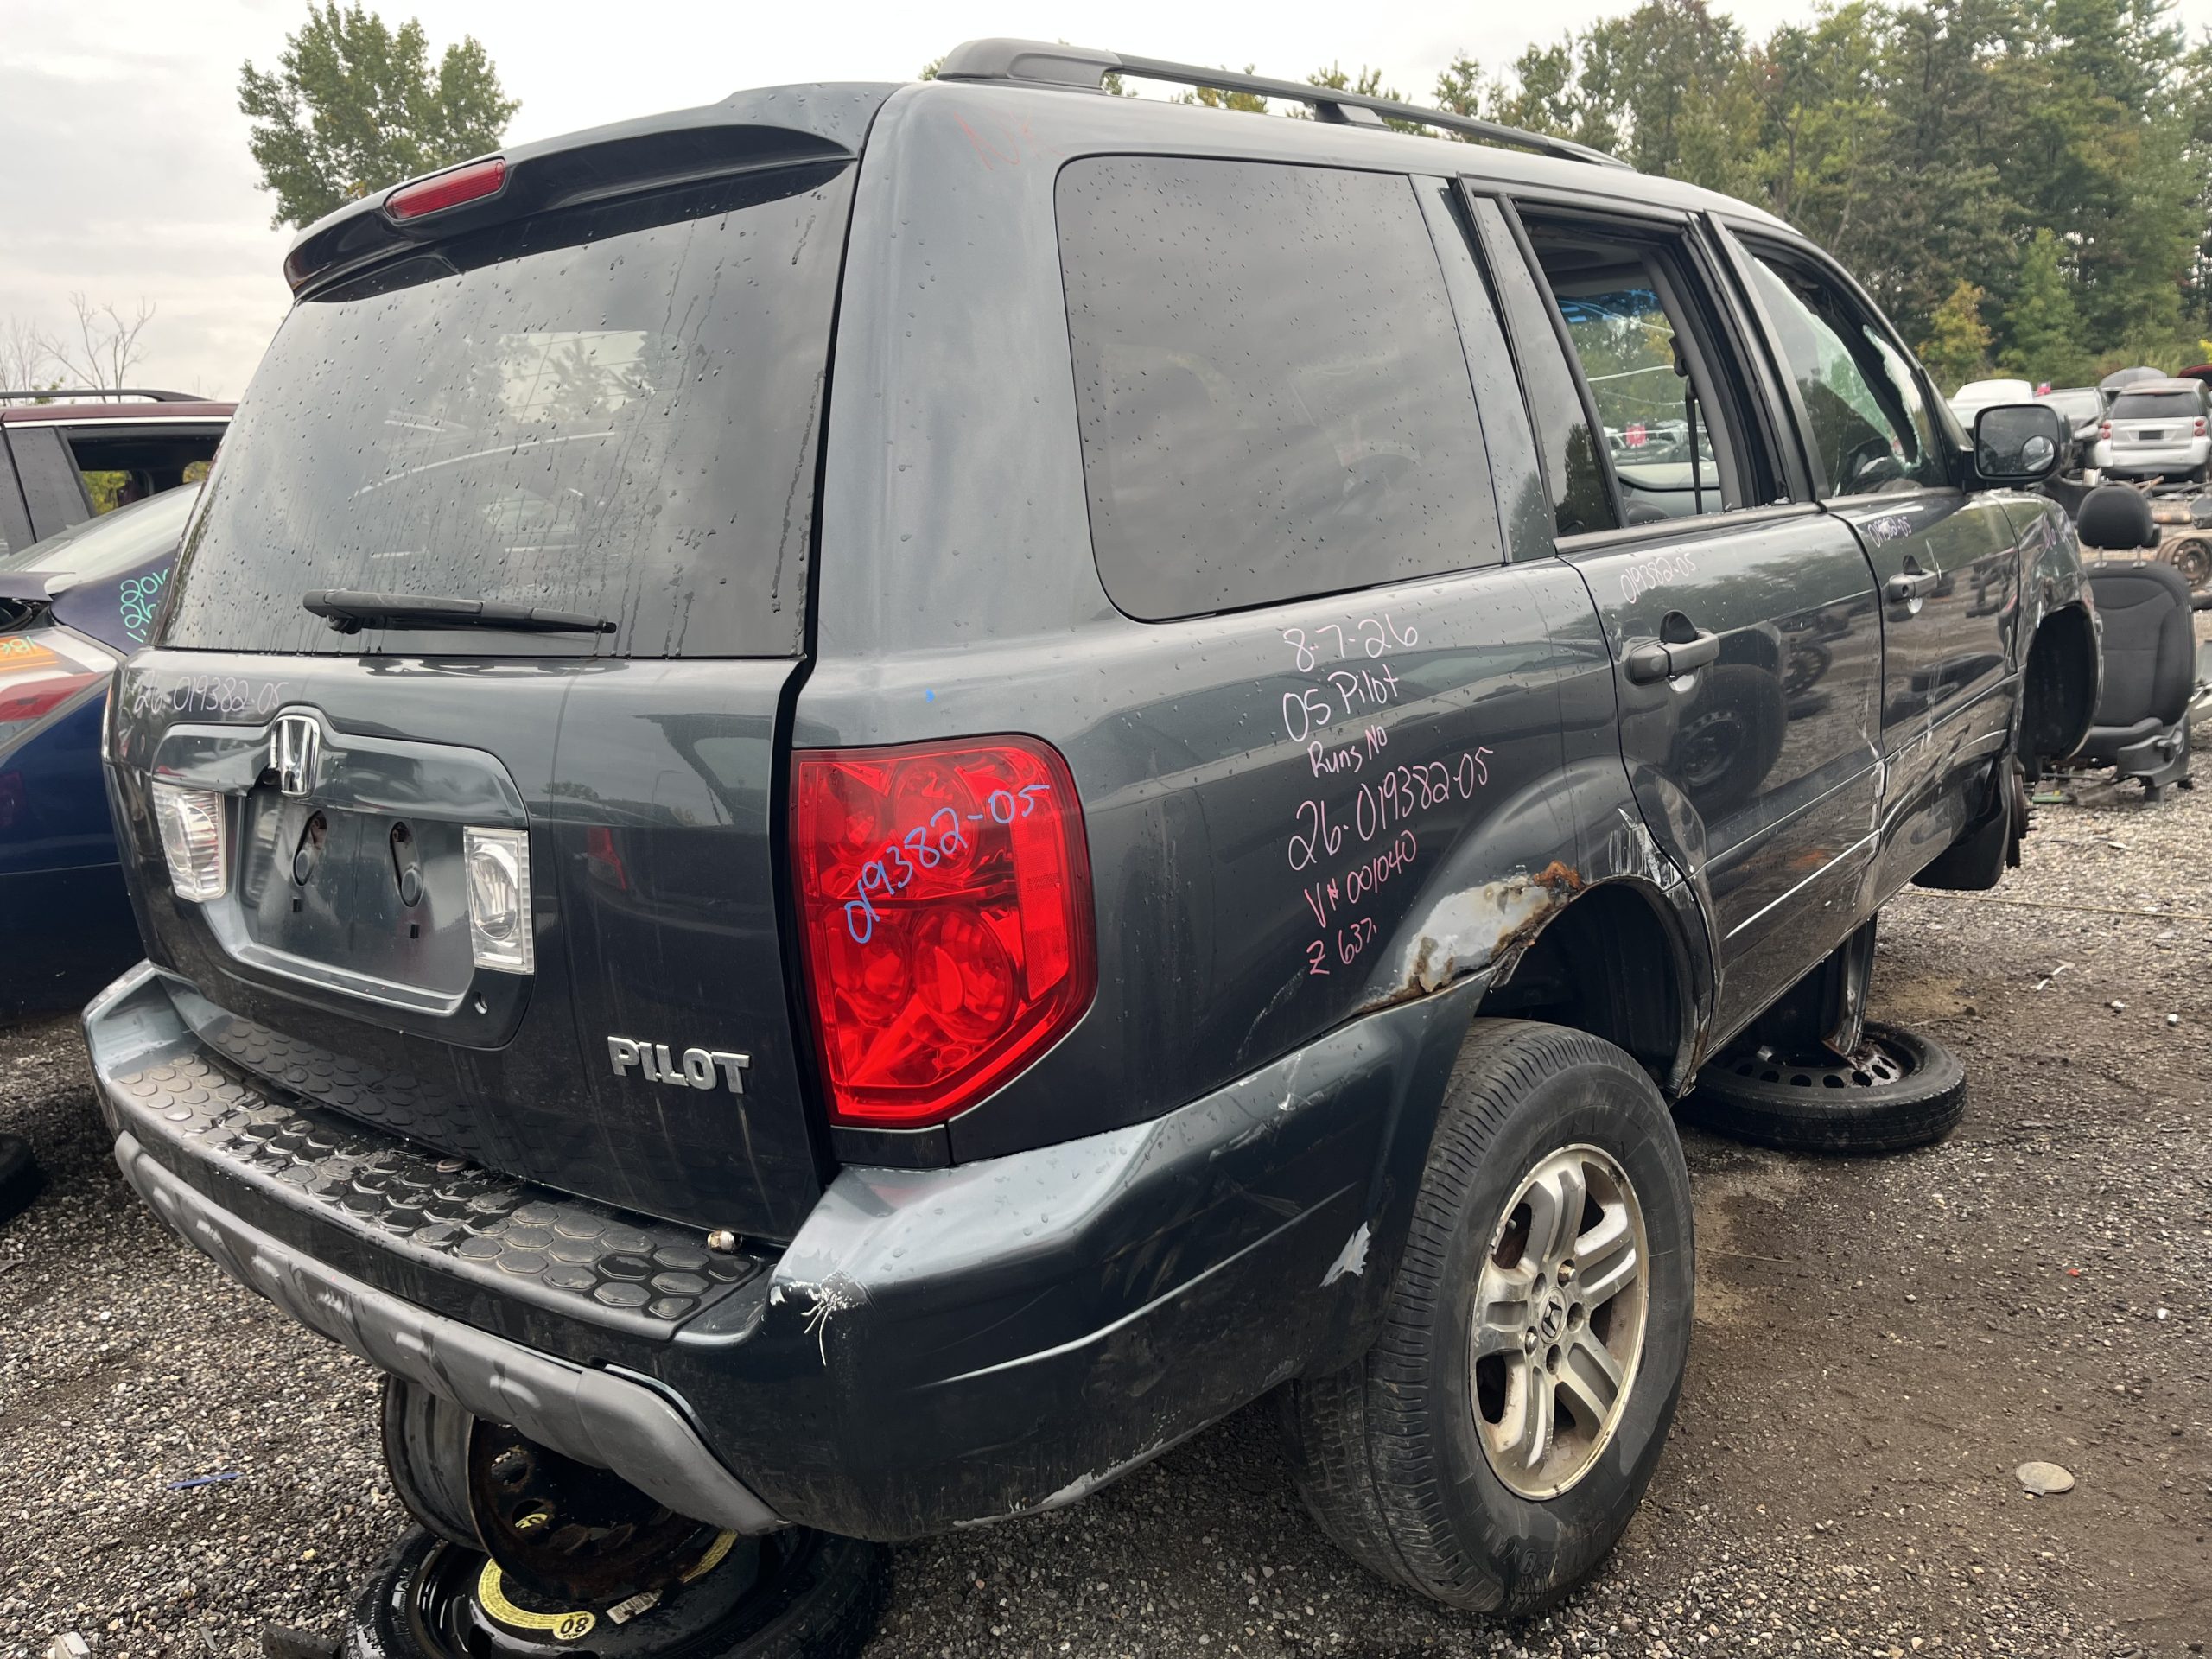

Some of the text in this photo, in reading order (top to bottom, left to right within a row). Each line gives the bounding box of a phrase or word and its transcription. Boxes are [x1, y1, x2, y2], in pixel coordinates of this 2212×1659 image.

[1282, 613, 1418, 673] 8-7-26
[1282, 663, 1400, 742] 05 Pilot
[1306, 740, 1363, 778] Runs
[843, 783, 1050, 944] 019382-05
[1346, 829, 1417, 905] 001040
[607, 1035, 751, 1095] PILOT
